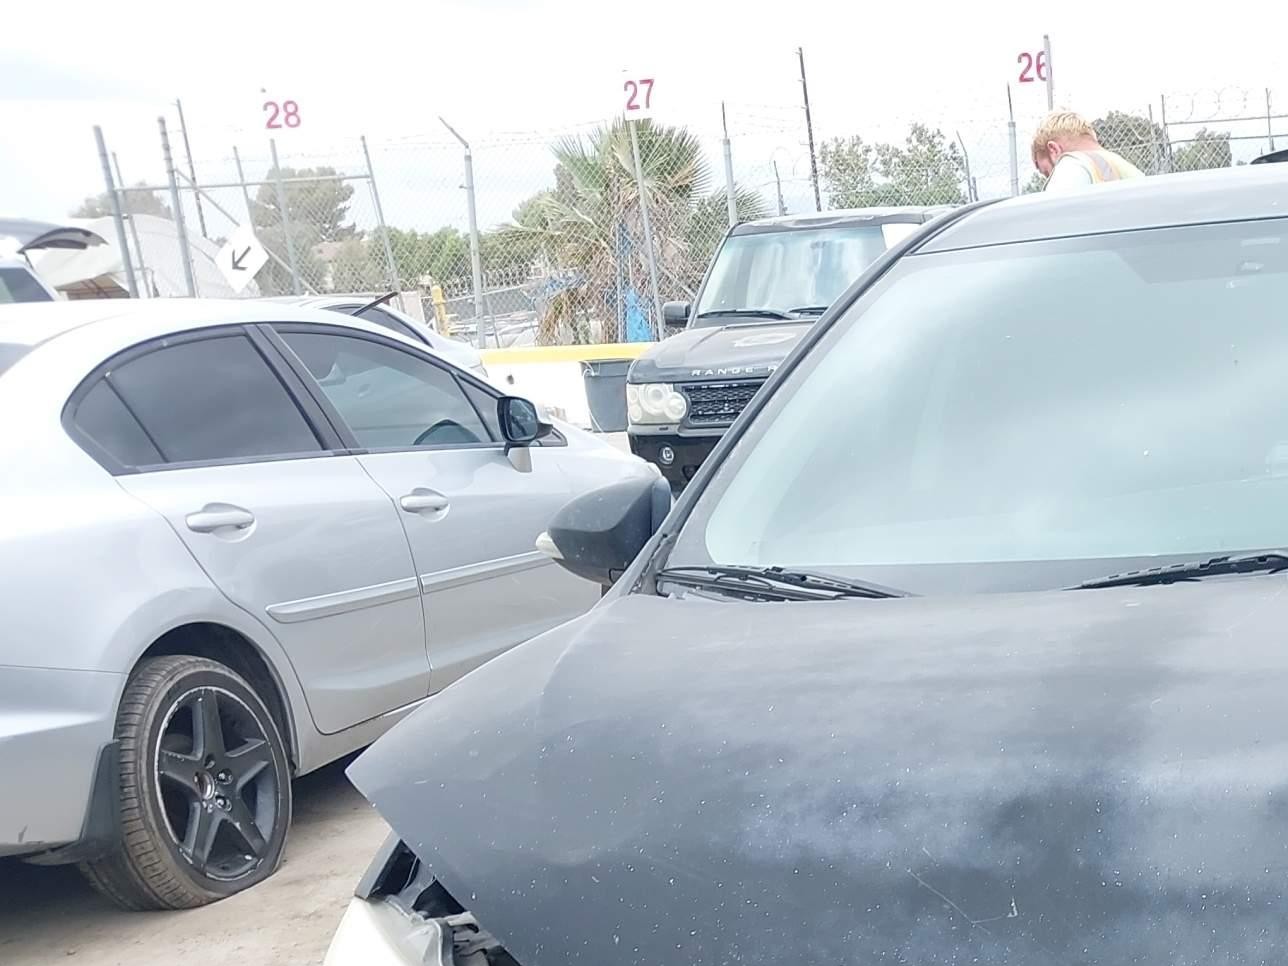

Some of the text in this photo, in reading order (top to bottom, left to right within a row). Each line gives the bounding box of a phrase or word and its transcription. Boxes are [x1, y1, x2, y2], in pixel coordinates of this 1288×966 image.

[1017, 51, 1047, 82] 26
[623, 78, 655, 110] 27
[262, 100, 301, 129] 28
[691, 366, 754, 377] RANGE
